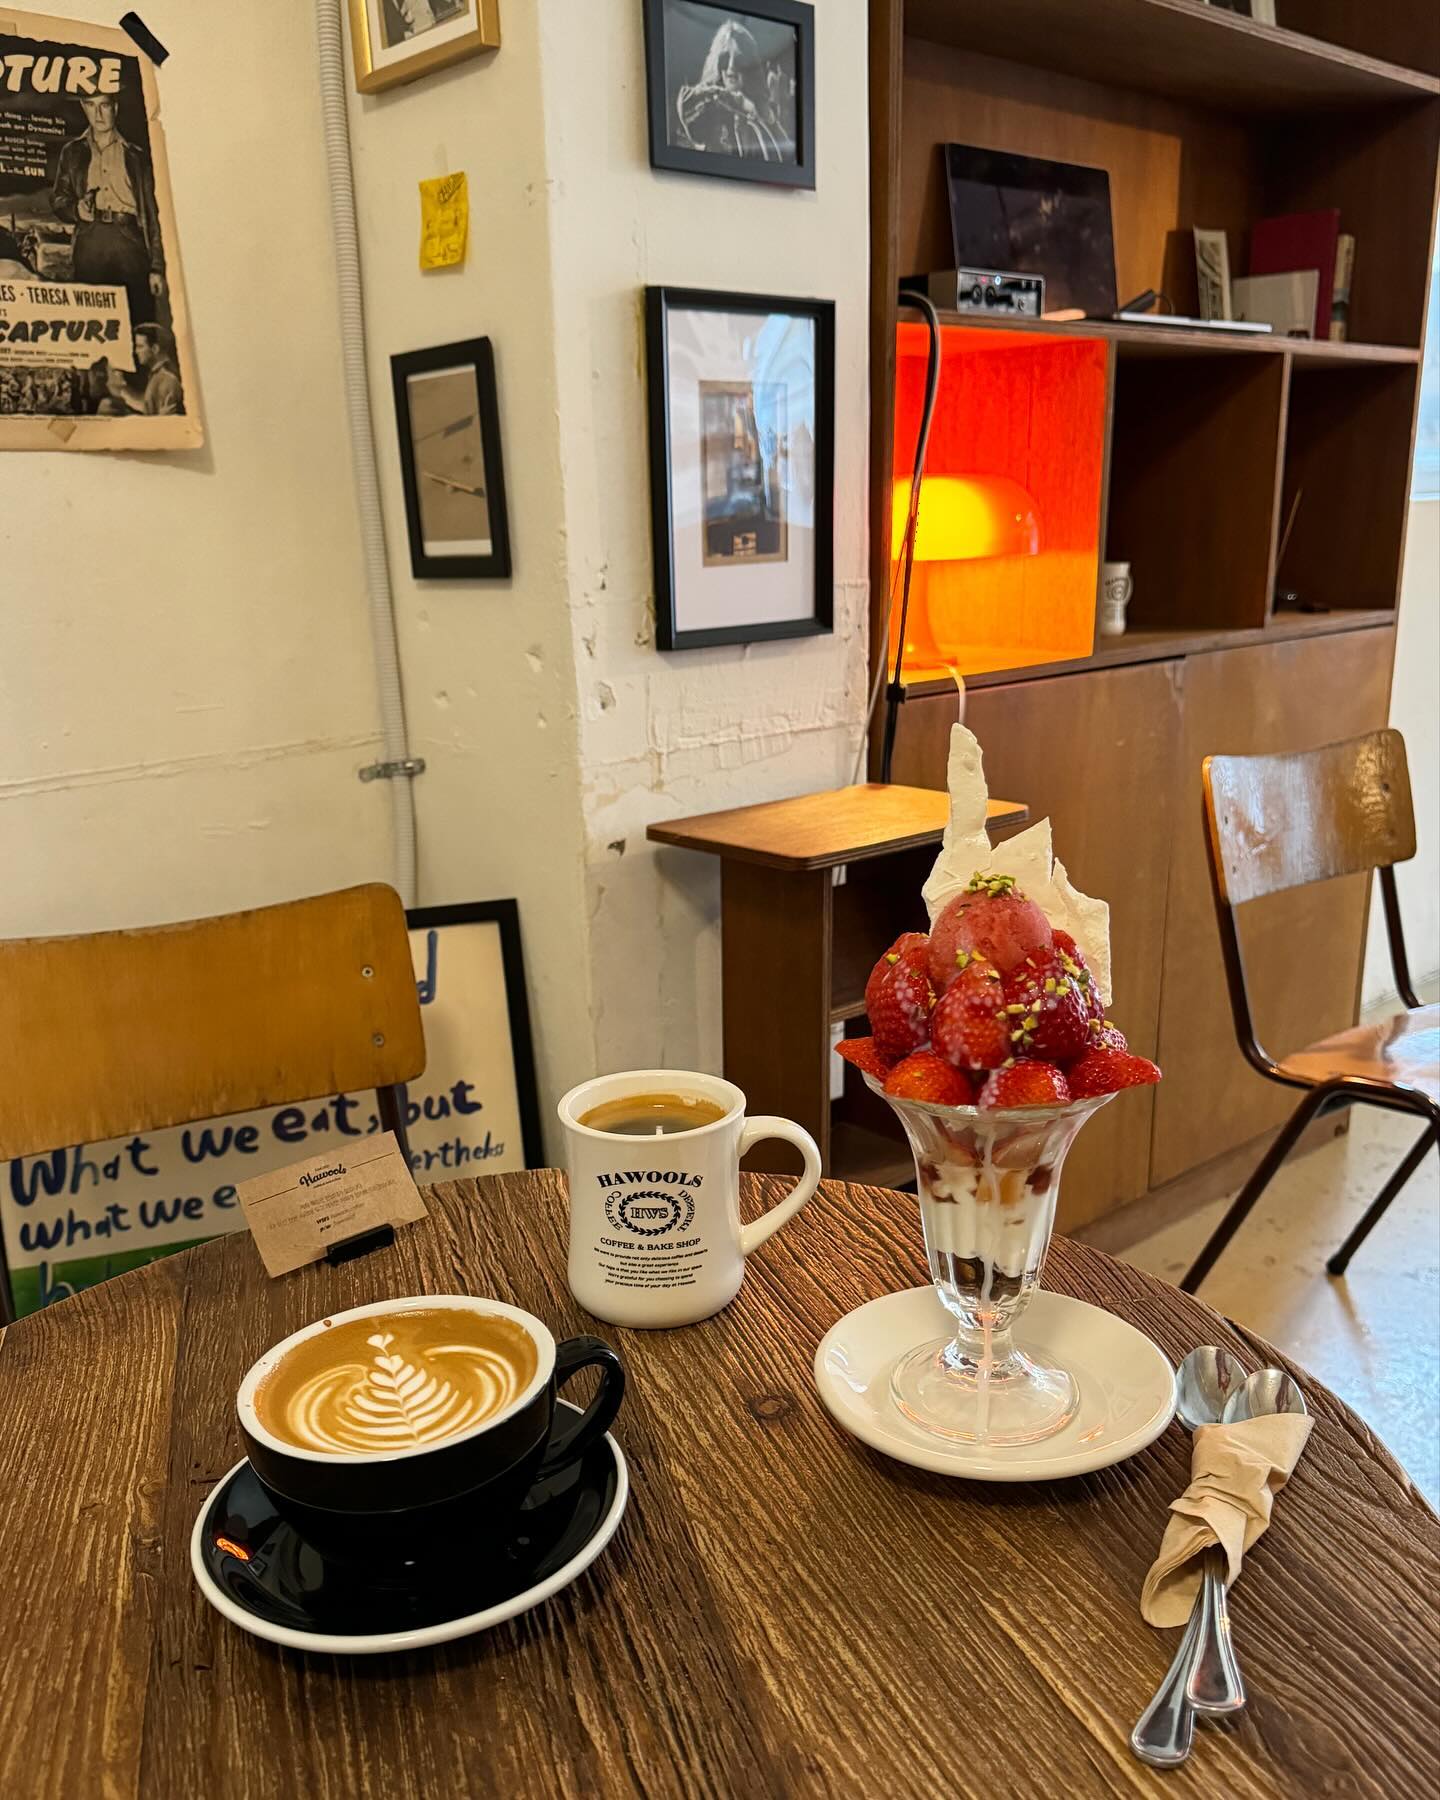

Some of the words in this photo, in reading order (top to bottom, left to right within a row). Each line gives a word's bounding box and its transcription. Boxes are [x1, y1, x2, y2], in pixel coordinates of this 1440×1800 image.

[24, 166, 45, 177] SUN
[0, 285, 16, 303] ES
[26, 286, 70, 306] TERESA
[73, 290, 117, 309] WRIGHT
[0, 319, 120, 344] CAPTURE
[10, 1137, 159, 1206] What
[182, 1126, 259, 1163] we
[272, 1093, 380, 1142] eat,
[402, 1080, 482, 1127] but
[299, 1163, 347, 1187] Hawools
[597, 1170, 704, 1188] HAWOOLS
[604, 1190, 623, 1231] COFFEE
[630, 1207, 669, 1219] HWS
[677, 1189, 695, 1232] DESSERT
[20, 1204, 131, 1251] what
[139, 1196, 204, 1228] we
[600, 1237, 635, 1250] COFFEE
[646, 1242, 674, 1251] BAKE
[675, 1237, 701, 1249] SHOP
